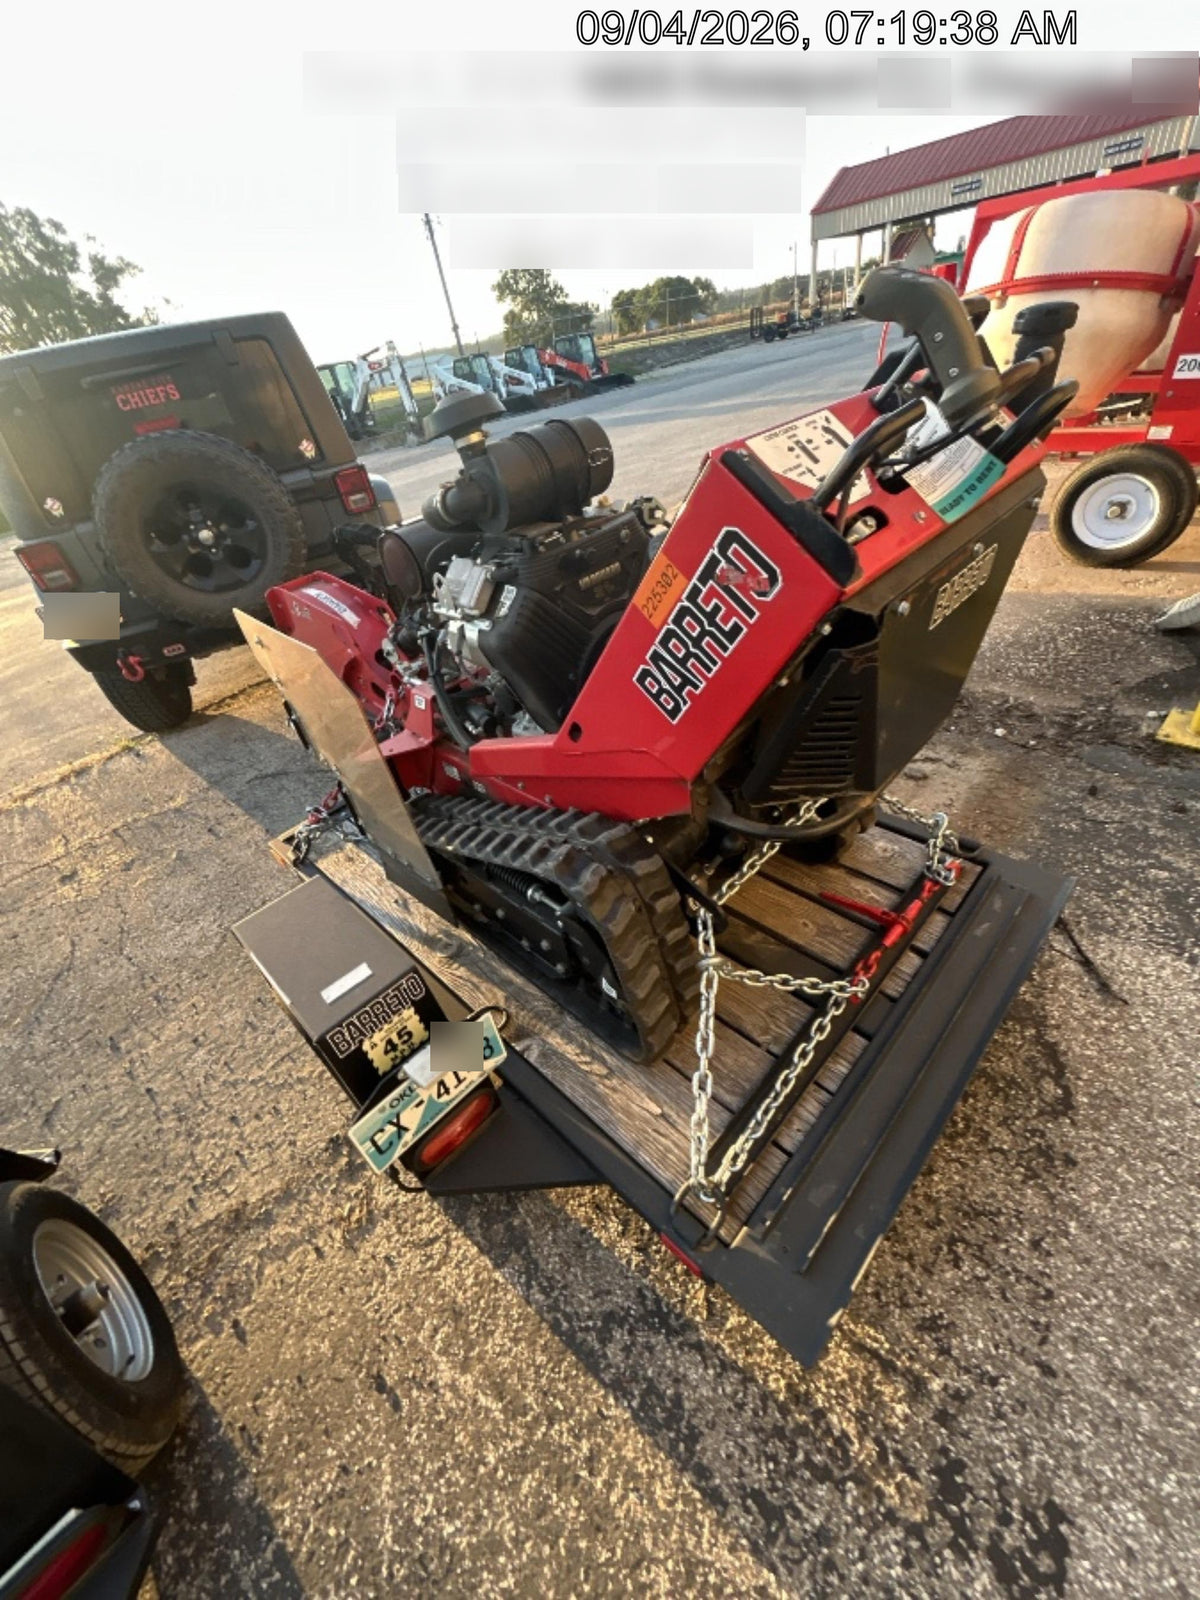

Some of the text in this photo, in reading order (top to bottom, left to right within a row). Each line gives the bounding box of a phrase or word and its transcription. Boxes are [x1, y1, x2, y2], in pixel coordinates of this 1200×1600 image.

[1176, 358, 1200, 373] 20
[116, 382, 181, 412] CHIEFS
[938, 460, 998, 517] READY TO RENT
[642, 563, 679, 619] 225302
[633, 526, 783, 725] BARRETO
[326, 972, 426, 1059] BARRETO
[383, 1025, 414, 1057] 45
